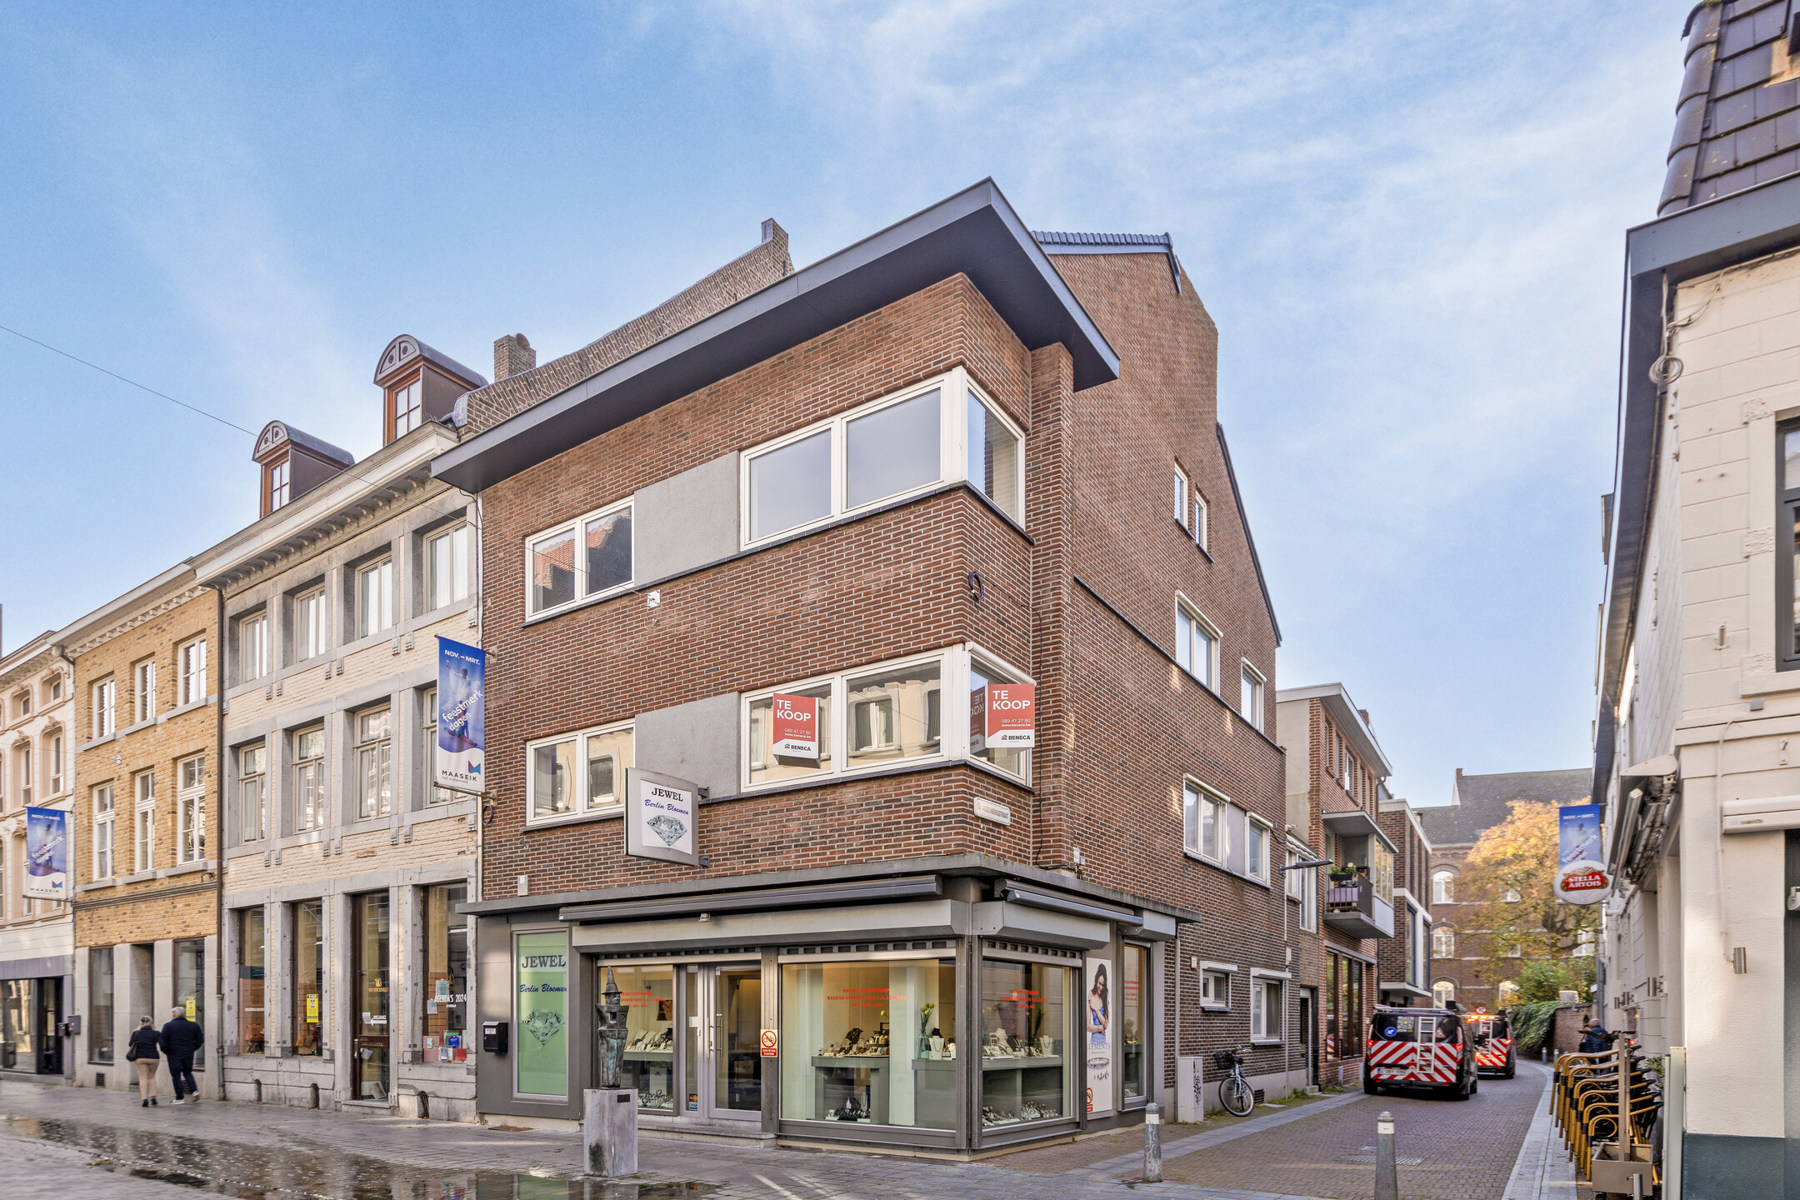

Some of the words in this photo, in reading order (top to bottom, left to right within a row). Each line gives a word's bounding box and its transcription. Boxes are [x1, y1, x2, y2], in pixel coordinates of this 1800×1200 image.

[444, 649, 460, 659] NOV.
[465, 655, 481, 666] MRT.
[992, 690, 1009, 700] TE
[441, 690, 483, 723] feestmerk
[776, 699, 792, 710] TE
[992, 700, 1031, 710] KOOP
[448, 712, 472, 731] dagen
[776, 709, 812, 722] KOOP
[441, 769, 478, 782] MAASEIK
[651, 787, 684, 802] JEWEL
[644, 798, 665, 809] Berlin
[666, 803, 689, 815] Bloemen
[1568, 874, 1601, 883] STELLA
[521, 954, 567, 969] JEWEL
[519, 983, 539, 993] Berlin
[541, 982, 568, 993] Bloemen
